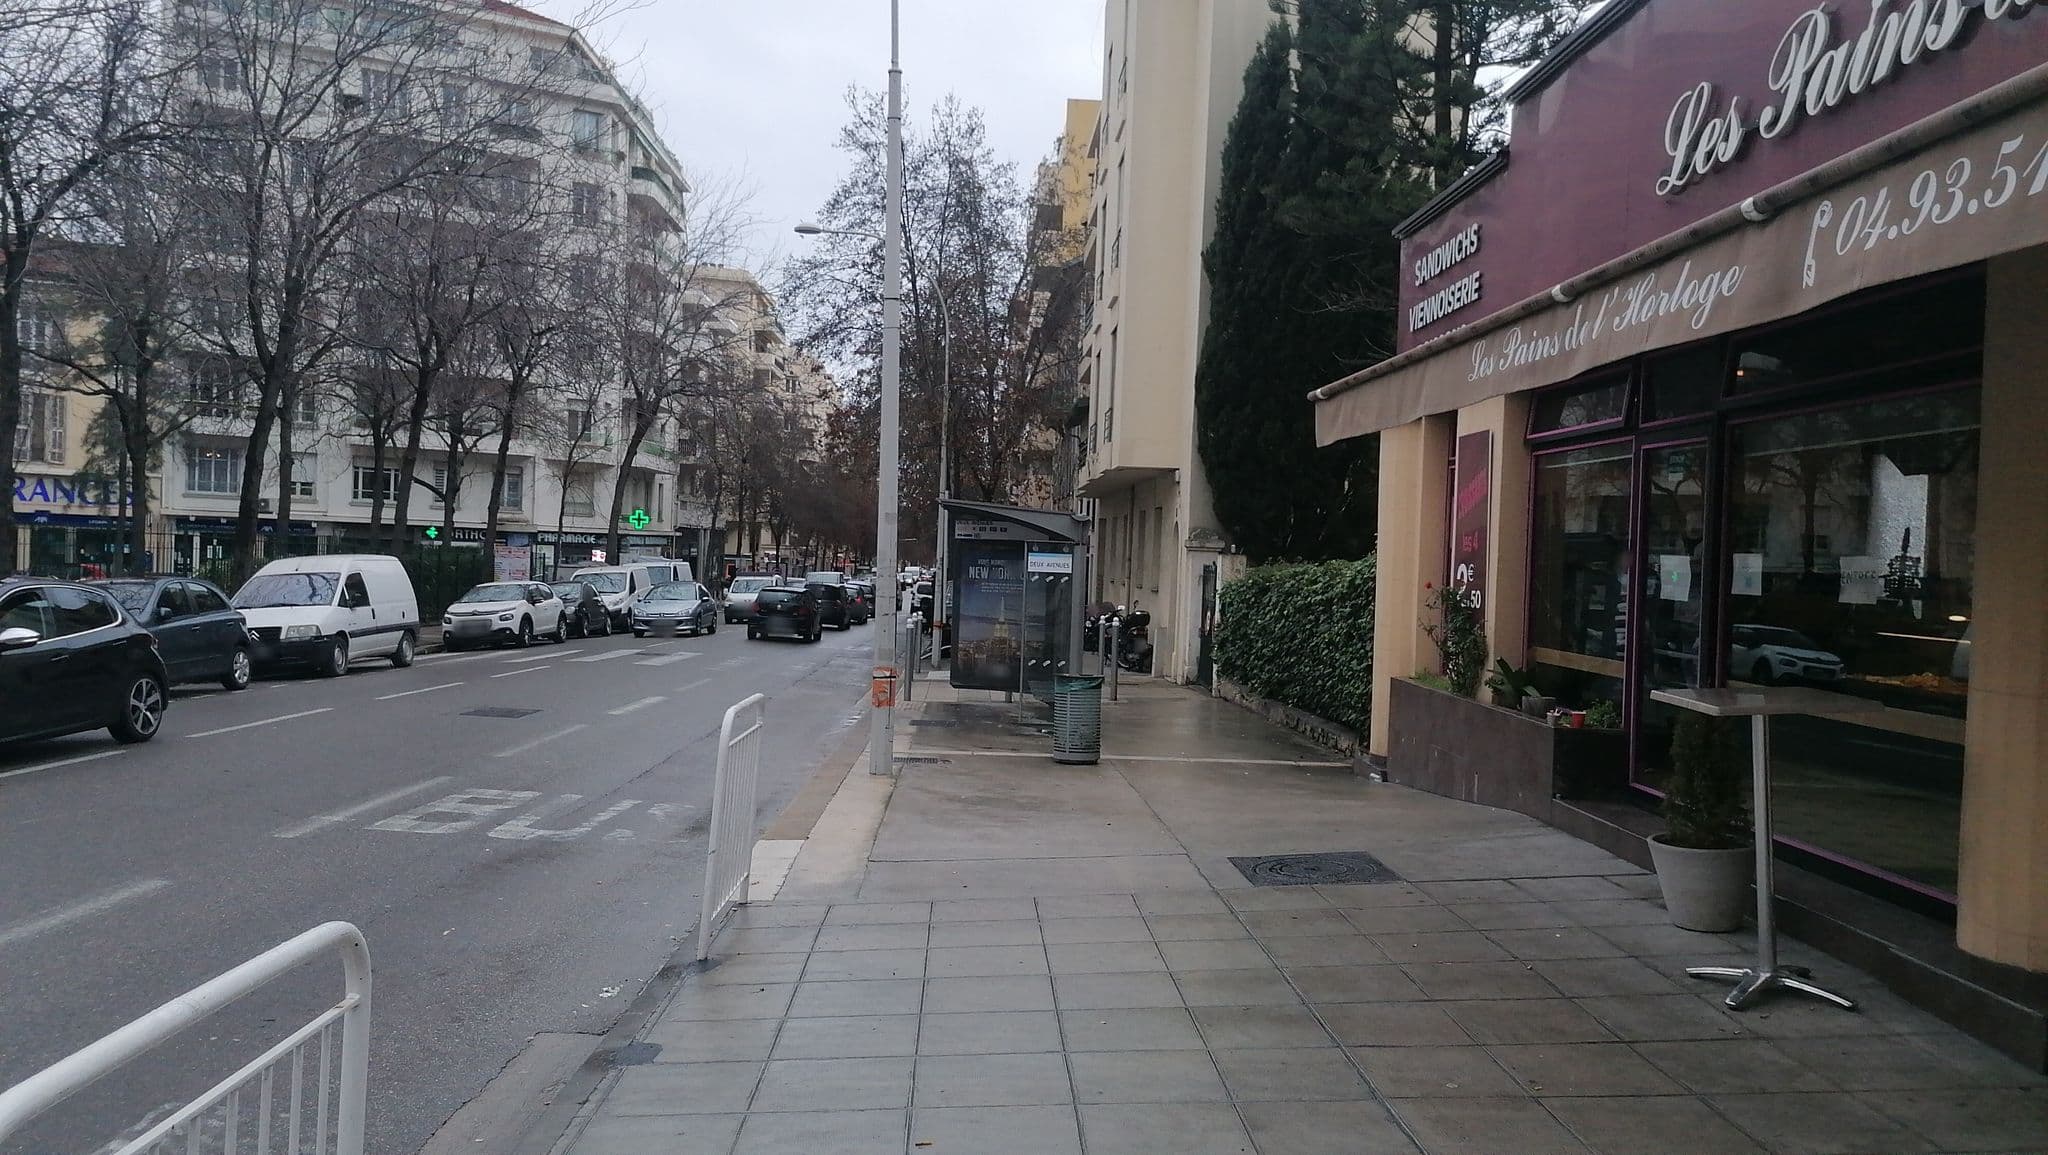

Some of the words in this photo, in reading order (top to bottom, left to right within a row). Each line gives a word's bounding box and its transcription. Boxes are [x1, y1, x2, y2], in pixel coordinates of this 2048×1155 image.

[1656, 81, 1745, 196] Les
[1759, 0, 1969, 139] Pains
[1414, 222, 1480, 287] SANDWICHS
[1408, 270, 1481, 333] VIENNOISERIE
[1467, 338, 1495, 382] Les
[1498, 327, 1561, 371] Pains
[1564, 305, 1588, 351] de
[451, 528, 487, 541] RTHO
[537, 532, 597, 544] PHARMACIE
[968, 565, 990, 580] NEW
[1046, 561, 1071, 569] AVENUES
[1470, 590, 1482, 609] 50
